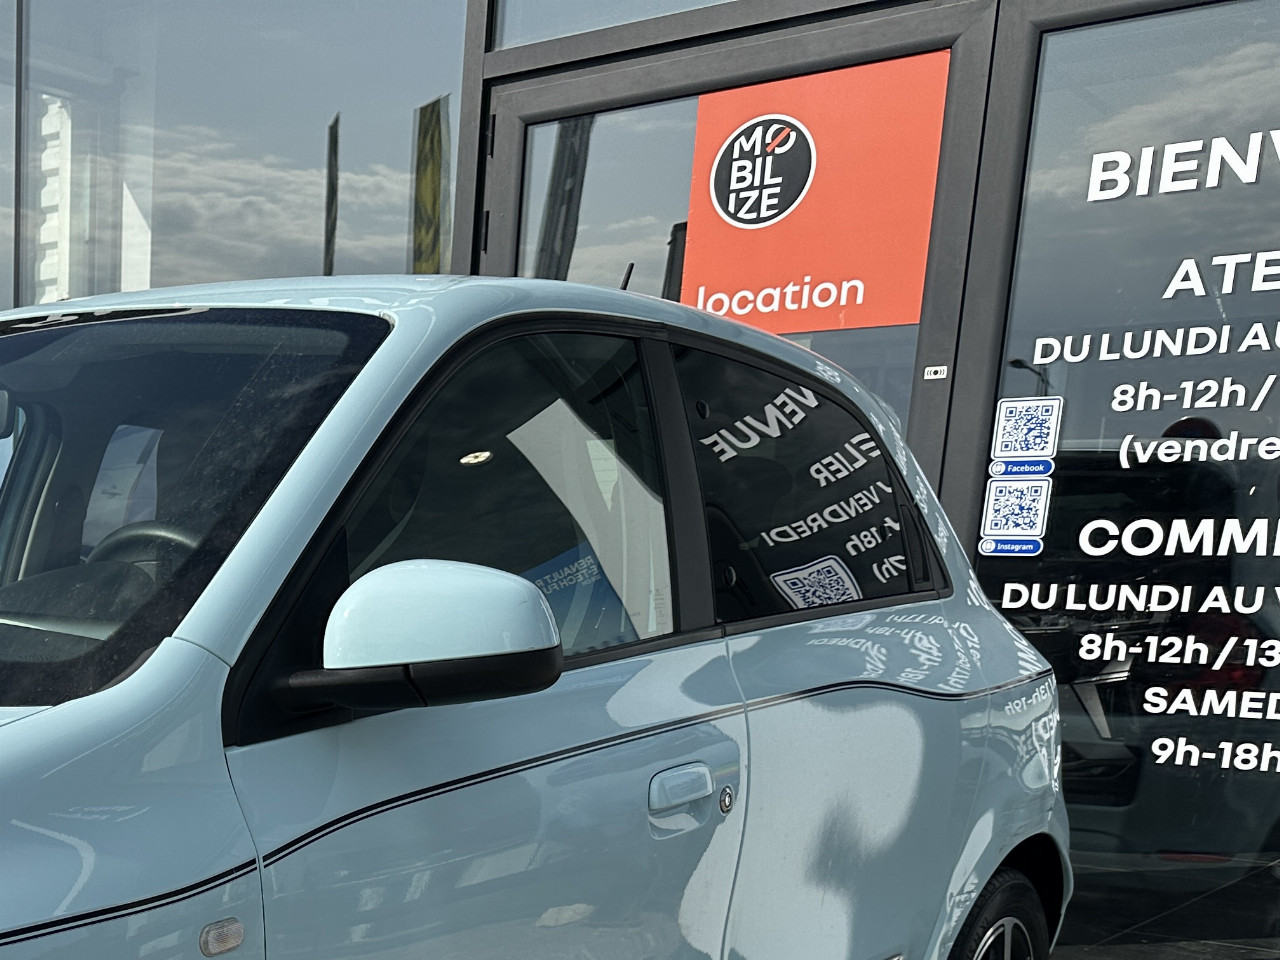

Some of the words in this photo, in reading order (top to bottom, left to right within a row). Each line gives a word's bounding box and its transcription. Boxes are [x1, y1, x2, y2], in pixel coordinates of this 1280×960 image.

[730, 155, 783, 190] BIL
[728, 186, 782, 220] IZE
[1162, 251, 1280, 299] ATE
[697, 276, 865, 317] location
[1032, 335, 1092, 365] DU
[1099, 325, 1232, 362] LUNDI
[1237, 320, 1280, 353] A
[1111, 376, 1247, 412] 8h-12h
[1119, 431, 1280, 469] (vendre
[1007, 464, 1045, 472] Facebook
[996, 543, 1034, 552] Instagram
[1001, 583, 1058, 609] DU
[1066, 585, 1193, 612] LUNDI
[1198, 586, 1265, 614] AU
[1078, 633, 1209, 664] 8h-12h
[1151, 737, 1280, 772] 9h-18h
